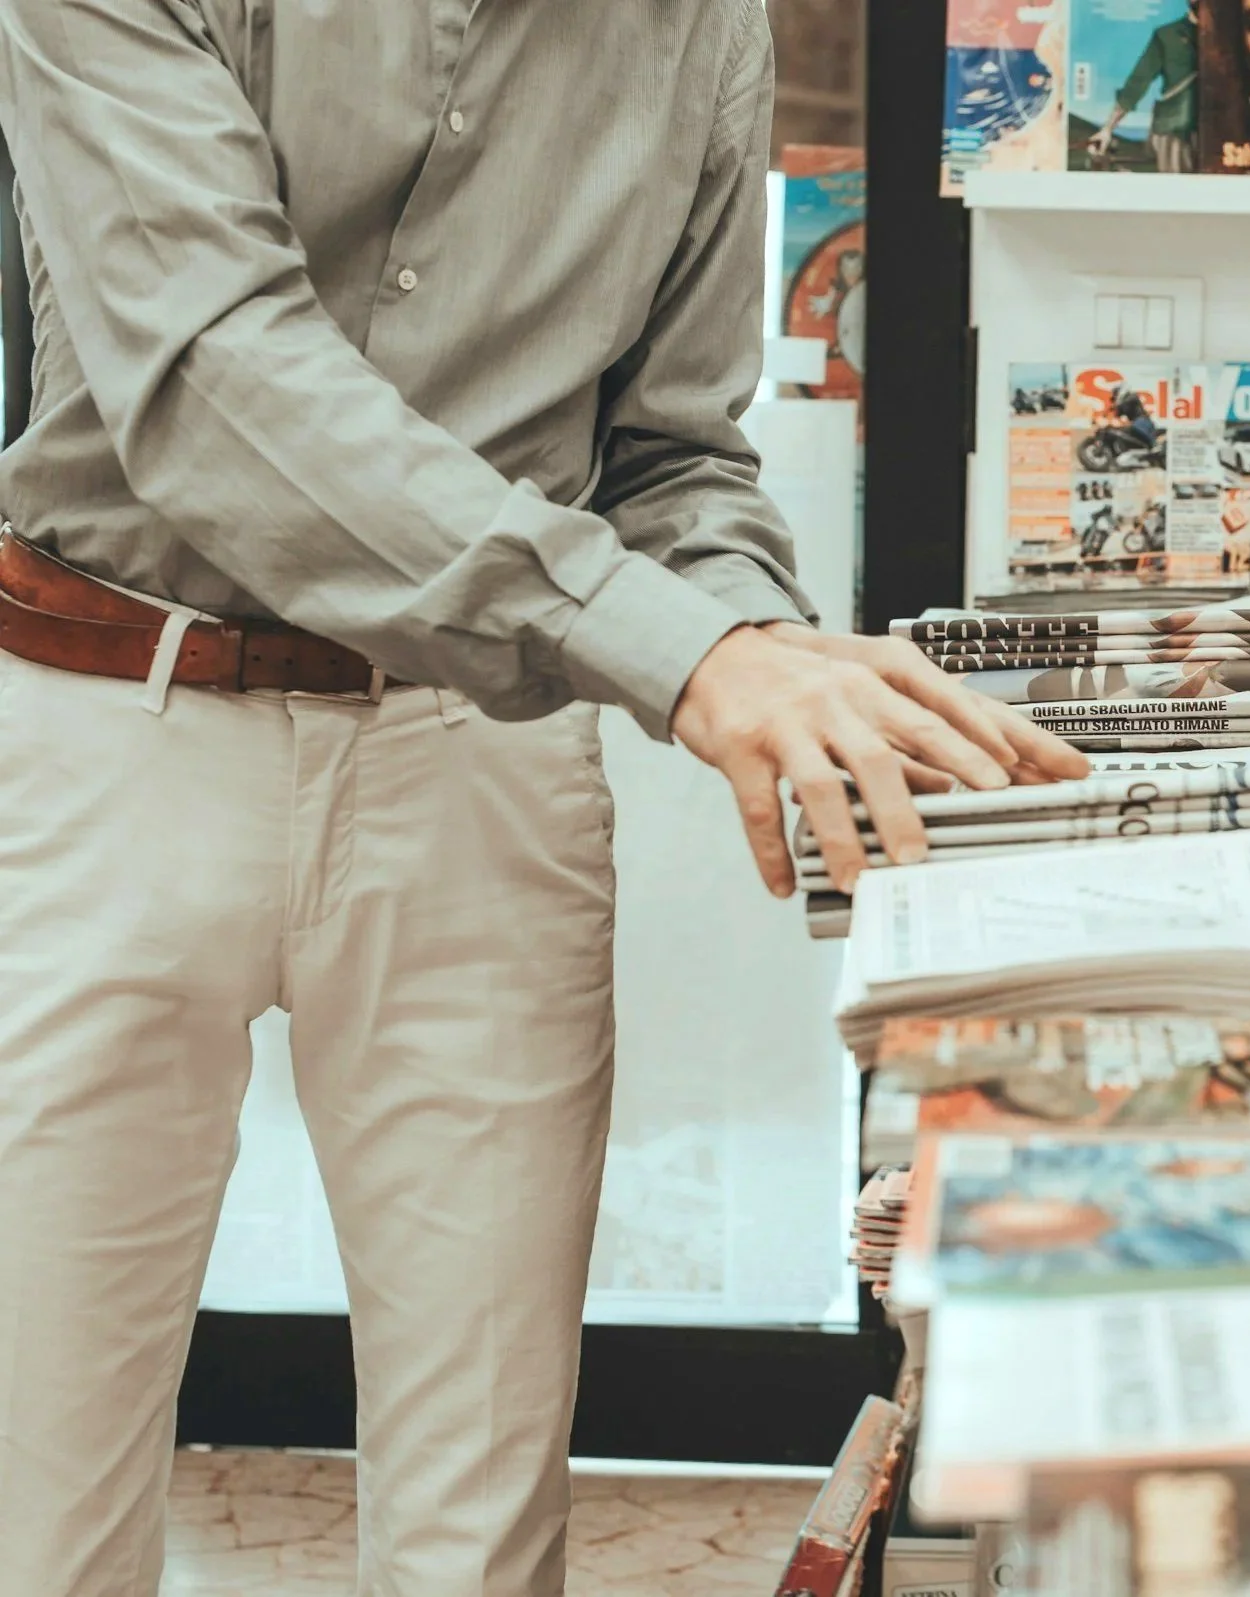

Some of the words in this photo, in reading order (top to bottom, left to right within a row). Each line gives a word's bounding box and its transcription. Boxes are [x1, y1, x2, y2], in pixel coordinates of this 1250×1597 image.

[1032, 705, 1085, 719] QUELLO
[1089, 703, 1167, 716] SBAGLIATO
[1171, 699, 1227, 713] RIMANE
[1092, 720, 1170, 732] SBAGLIATO
[1174, 718, 1230, 731] RIMANE
